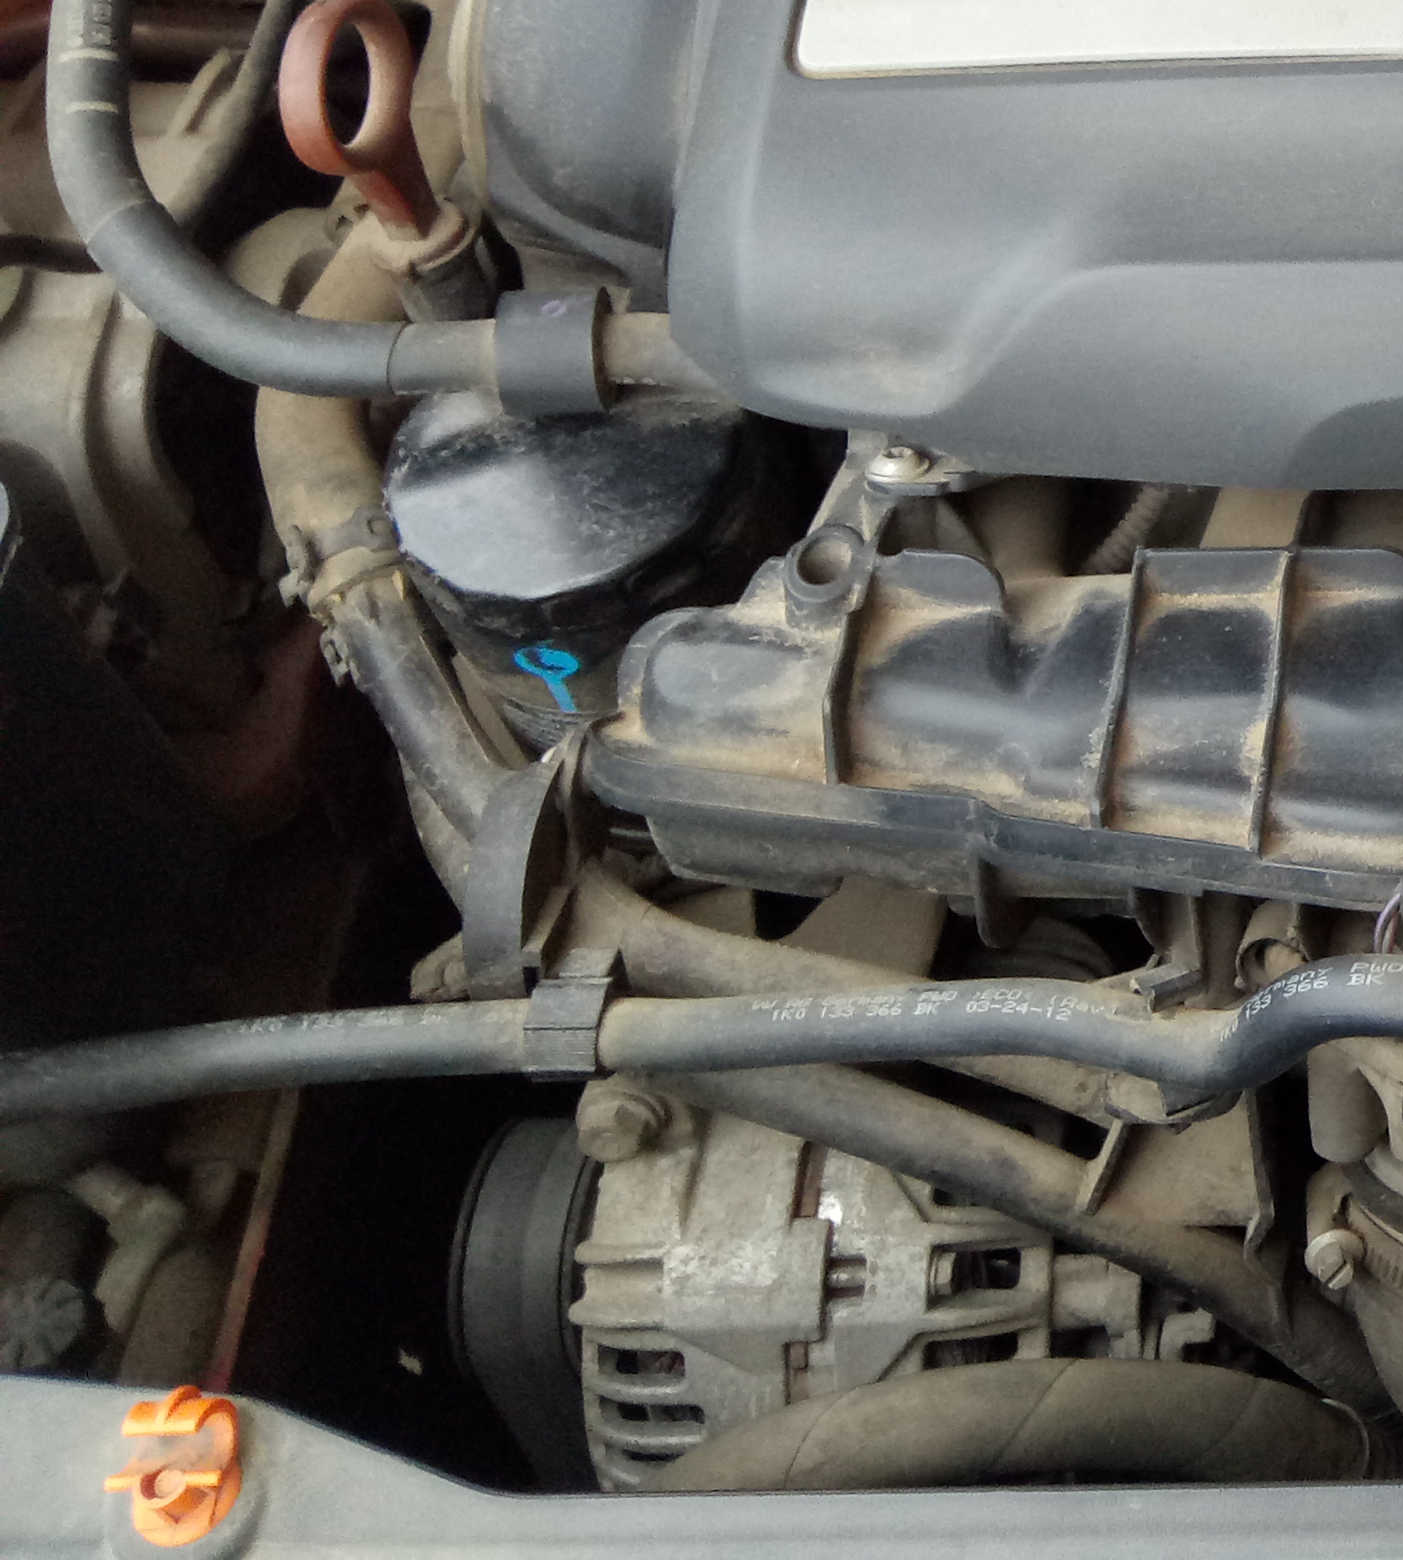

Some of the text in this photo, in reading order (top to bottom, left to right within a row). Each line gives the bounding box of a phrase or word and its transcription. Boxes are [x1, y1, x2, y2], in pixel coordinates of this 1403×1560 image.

[1282, 976, 1330, 999] 366
[1346, 972, 1386, 986] BK
[966, 999, 1072, 1022] 03-24-12
